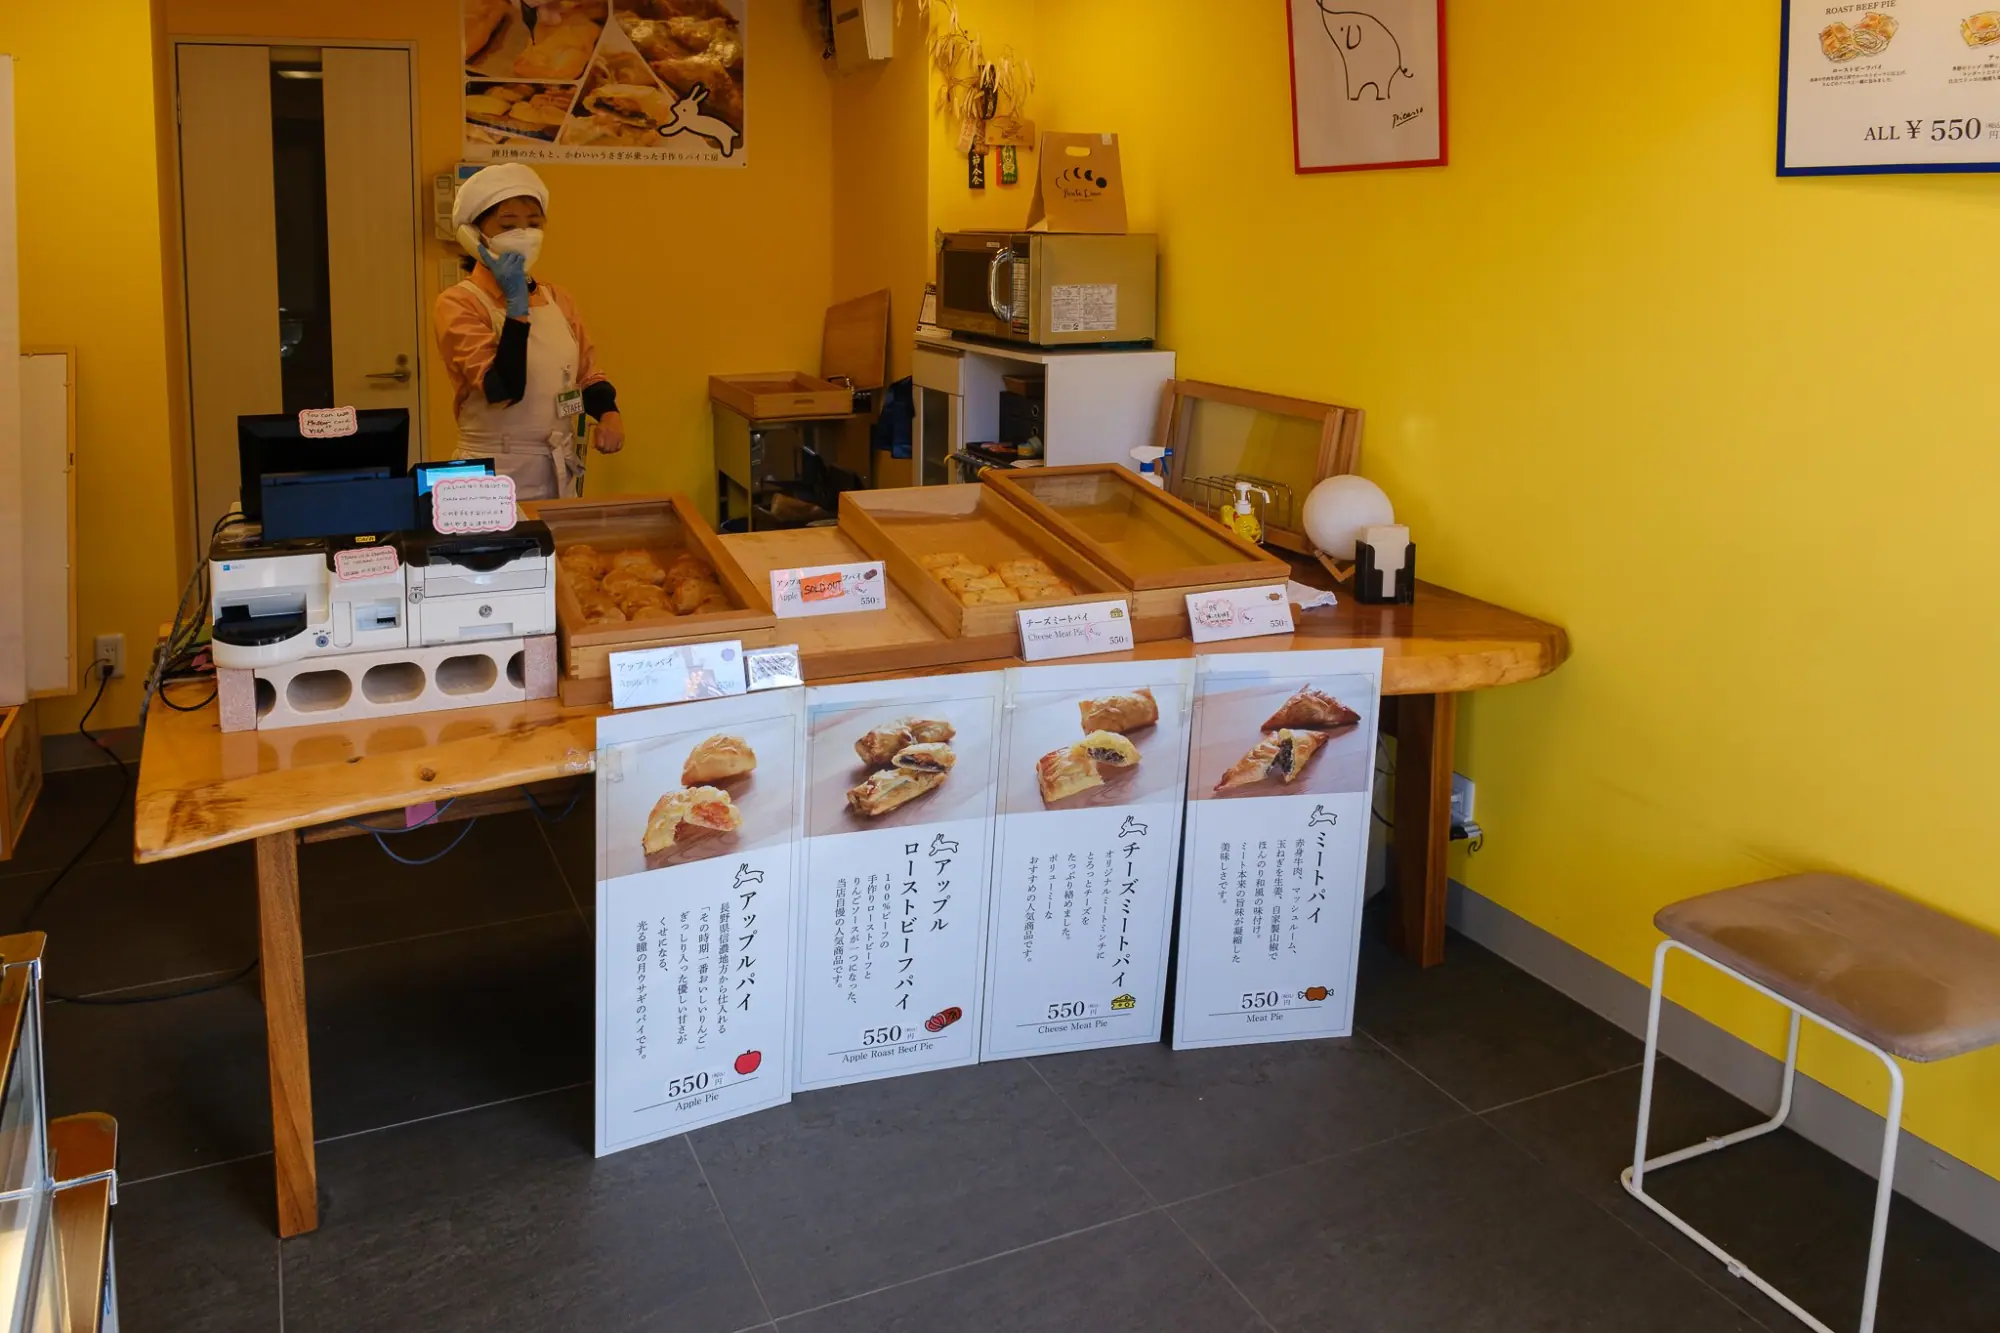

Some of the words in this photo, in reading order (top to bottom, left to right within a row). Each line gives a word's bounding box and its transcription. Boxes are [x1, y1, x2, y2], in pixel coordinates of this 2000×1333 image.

[1825, 5, 1854, 16] ROAST
[1855, 2, 1880, 12] BEEF
[1881, 0, 1897, 9] PIE
[1392, 107, 1424, 129] Picasso
[1864, 125, 1900, 141] ALL
[1906, 119, 1923, 140] ¥
[1930, 117, 1982, 142] 550
[562, 401, 581, 415] STAFF
[804, 583, 825, 595] SOLD
[827, 579, 842, 591] OUT
[860, 597, 876, 605] 550
[1026, 612, 1088, 628] チーズミートパイ
[1269, 619, 1284, 628] 550
[1028, 632, 1053, 642] Cheese
[1054, 628, 1071, 639] Meat
[1109, 635, 1124, 645] 550
[616, 656, 674, 673] アップルパイ
[1217, 841, 1231, 904] 美味しさです。
[1306, 831, 1326, 924] ミートパイ
[929, 858, 952, 933] アップル
[1044, 853, 1059, 920] ボリューミーな
[1081, 851, 1096, 926] とろっとチーズを
[1252, 841, 1268, 939] ほんのり和風の味付け。
[1022, 856, 1039, 963] おすすめの人気商品です。
[1111, 841, 1141, 988] チーズミートパイ
[832, 878, 847, 989] 当店自慢の人気商品です。
[863, 874, 878, 980] 手作りローストビーフと
[894, 842, 920, 1011] ローストビーフパイ
[657, 916, 669, 972] くせになる、
[736, 891, 758, 1012] アップルパイ
[847, 877, 861, 1004] りんごソースが一つになった、
[676, 910, 690, 1045] ぎっしり入った優しい甘さが
[717, 901, 732, 1034] 長野県信濃地方から仕入れる
[635, 920, 649, 1060] 光る瞳の月ウサギのパイです。
[1241, 990, 1279, 1009] 550
[1047, 1000, 1085, 1020] 550
[1246, 1013, 1269, 1024] Meat
[1270, 1012, 1284, 1022] Pie
[862, 1024, 902, 1047] 550
[1037, 1024, 1068, 1035] Cheese
[1070, 1021, 1092, 1031] Meat
[1095, 1019, 1108, 1028] Pie
[842, 1051, 869, 1064] Apple
[870, 1047, 895, 1060] Roast
[898, 1043, 918, 1054] Beef
[919, 1041, 934, 1051] Pie
[667, 1071, 710, 1098] 550
[675, 1096, 702, 1112] Apple
[704, 1091, 720, 1103] Pie
